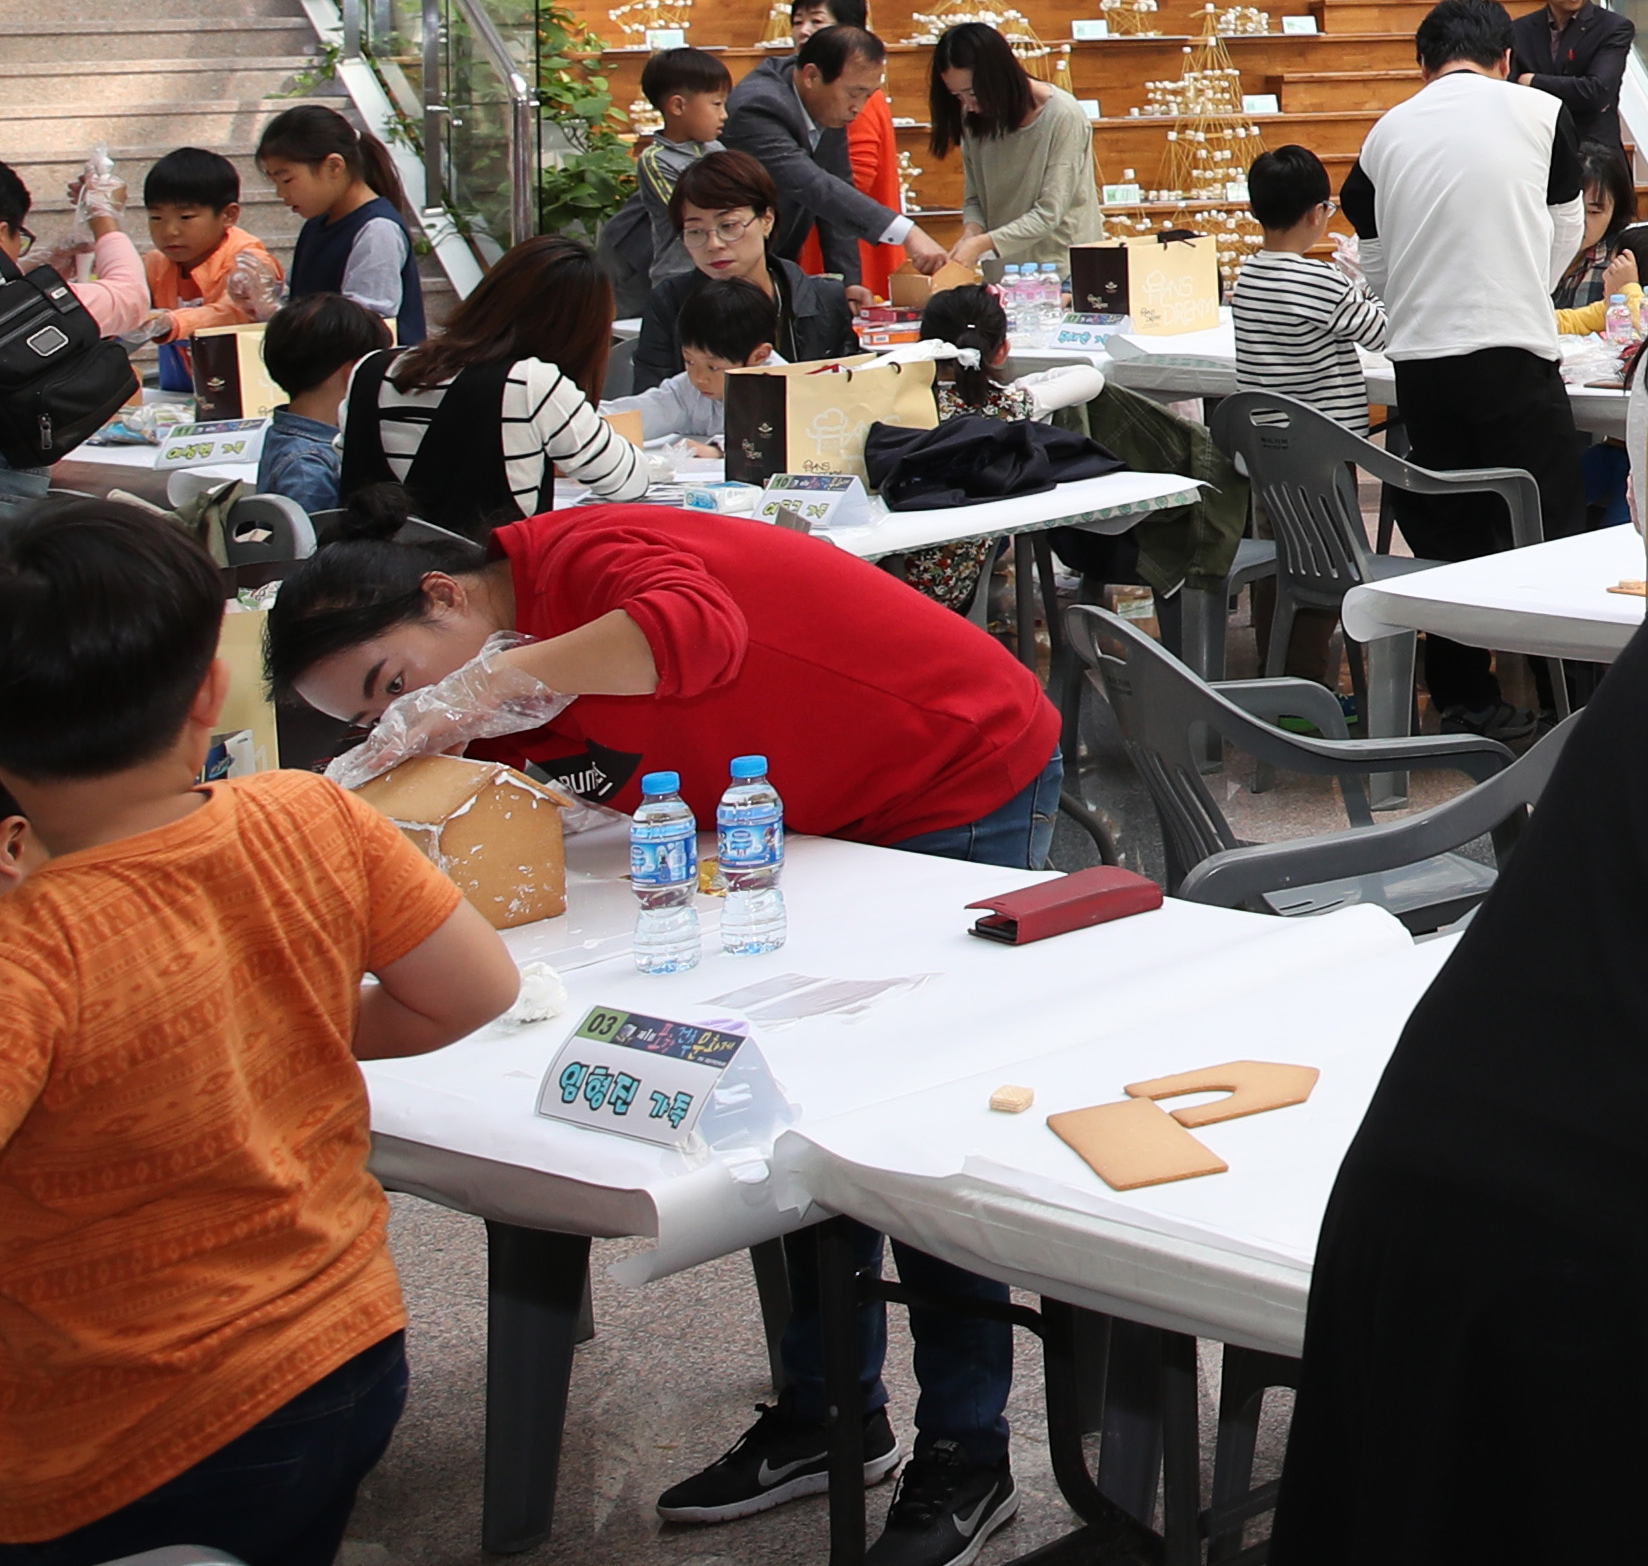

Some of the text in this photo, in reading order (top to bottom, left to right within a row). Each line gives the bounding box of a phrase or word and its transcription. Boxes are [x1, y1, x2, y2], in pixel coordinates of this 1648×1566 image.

[587, 1013, 618, 1035] 03
[559, 1061, 694, 1129] 임형진 가족
